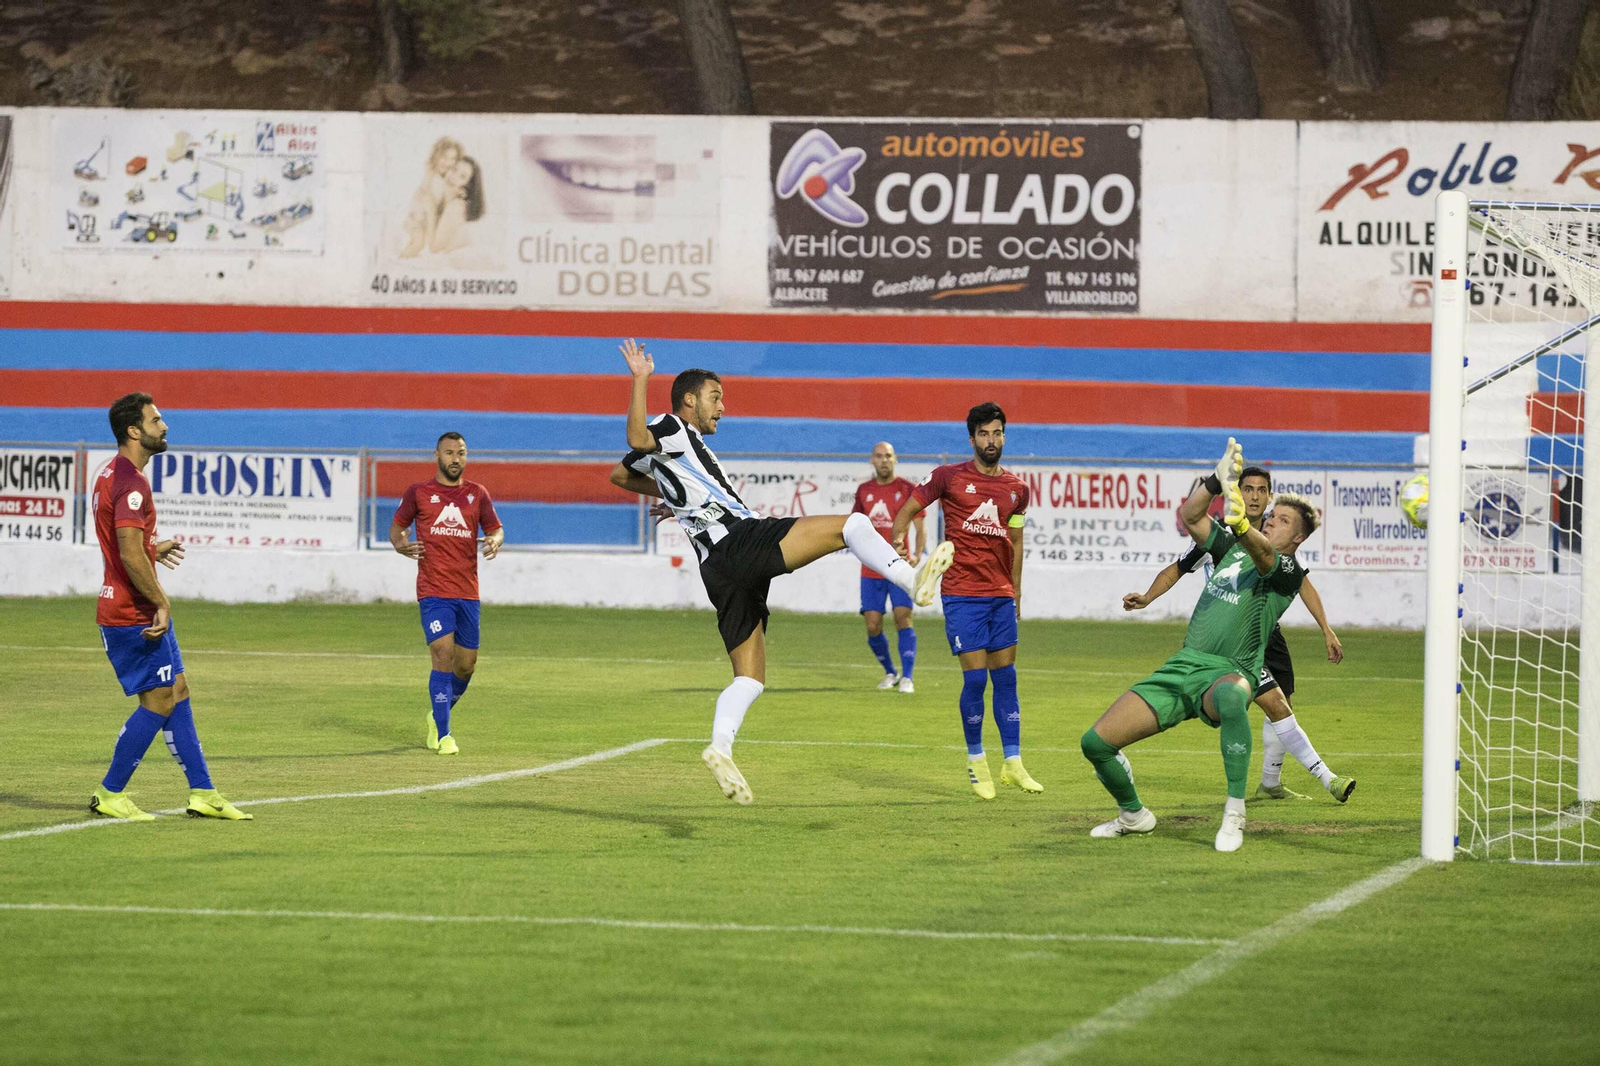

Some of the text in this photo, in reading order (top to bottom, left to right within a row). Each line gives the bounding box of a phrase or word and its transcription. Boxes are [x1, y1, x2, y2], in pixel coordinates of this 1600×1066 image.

[882, 131, 1085, 159] automóviles
[1316, 141, 1518, 212] Roble
[875, 172, 1135, 226] COLLADO
[1319, 221, 1435, 246] ALQUILE
[518, 231, 713, 265] Clínica Dental
[779, 229, 1135, 260] VEHÍCULOS DE OCASIÓN
[371, 274, 517, 294] 40 AÑOS A SU SERVICIO
[558, 271, 712, 298] DOBLAS
[872, 265, 1029, 297] Cuestión de confianza
[1066, 271, 1088, 286] 967
[774, 287, 828, 301] ALBACETE
[1045, 290, 1137, 305] VILLARROBLEDO
[152, 454, 350, 498] PROSEIN R
[1332, 480, 1391, 513] Transportes
[25, 500, 43, 515] 24
[46, 498, 63, 516] H.
[8, 522, 20, 538] 14
[25, 524, 42, 540] 44
[46, 525, 63, 541] 56
[430, 526, 472, 538] PARCITANK
[962, 521, 1008, 538] PARCITANK
[1054, 518, 1165, 532] PINTURA
[225, 536, 250, 546] 14
[1040, 550, 1067, 561] 146
[1074, 551, 1104, 561] 233
[1121, 552, 1150, 563] 677
[1413, 554, 1421, 566] 2
[429, 619, 443, 634] 18
[954, 635, 962, 649] 4
[157, 664, 172, 682] 17
